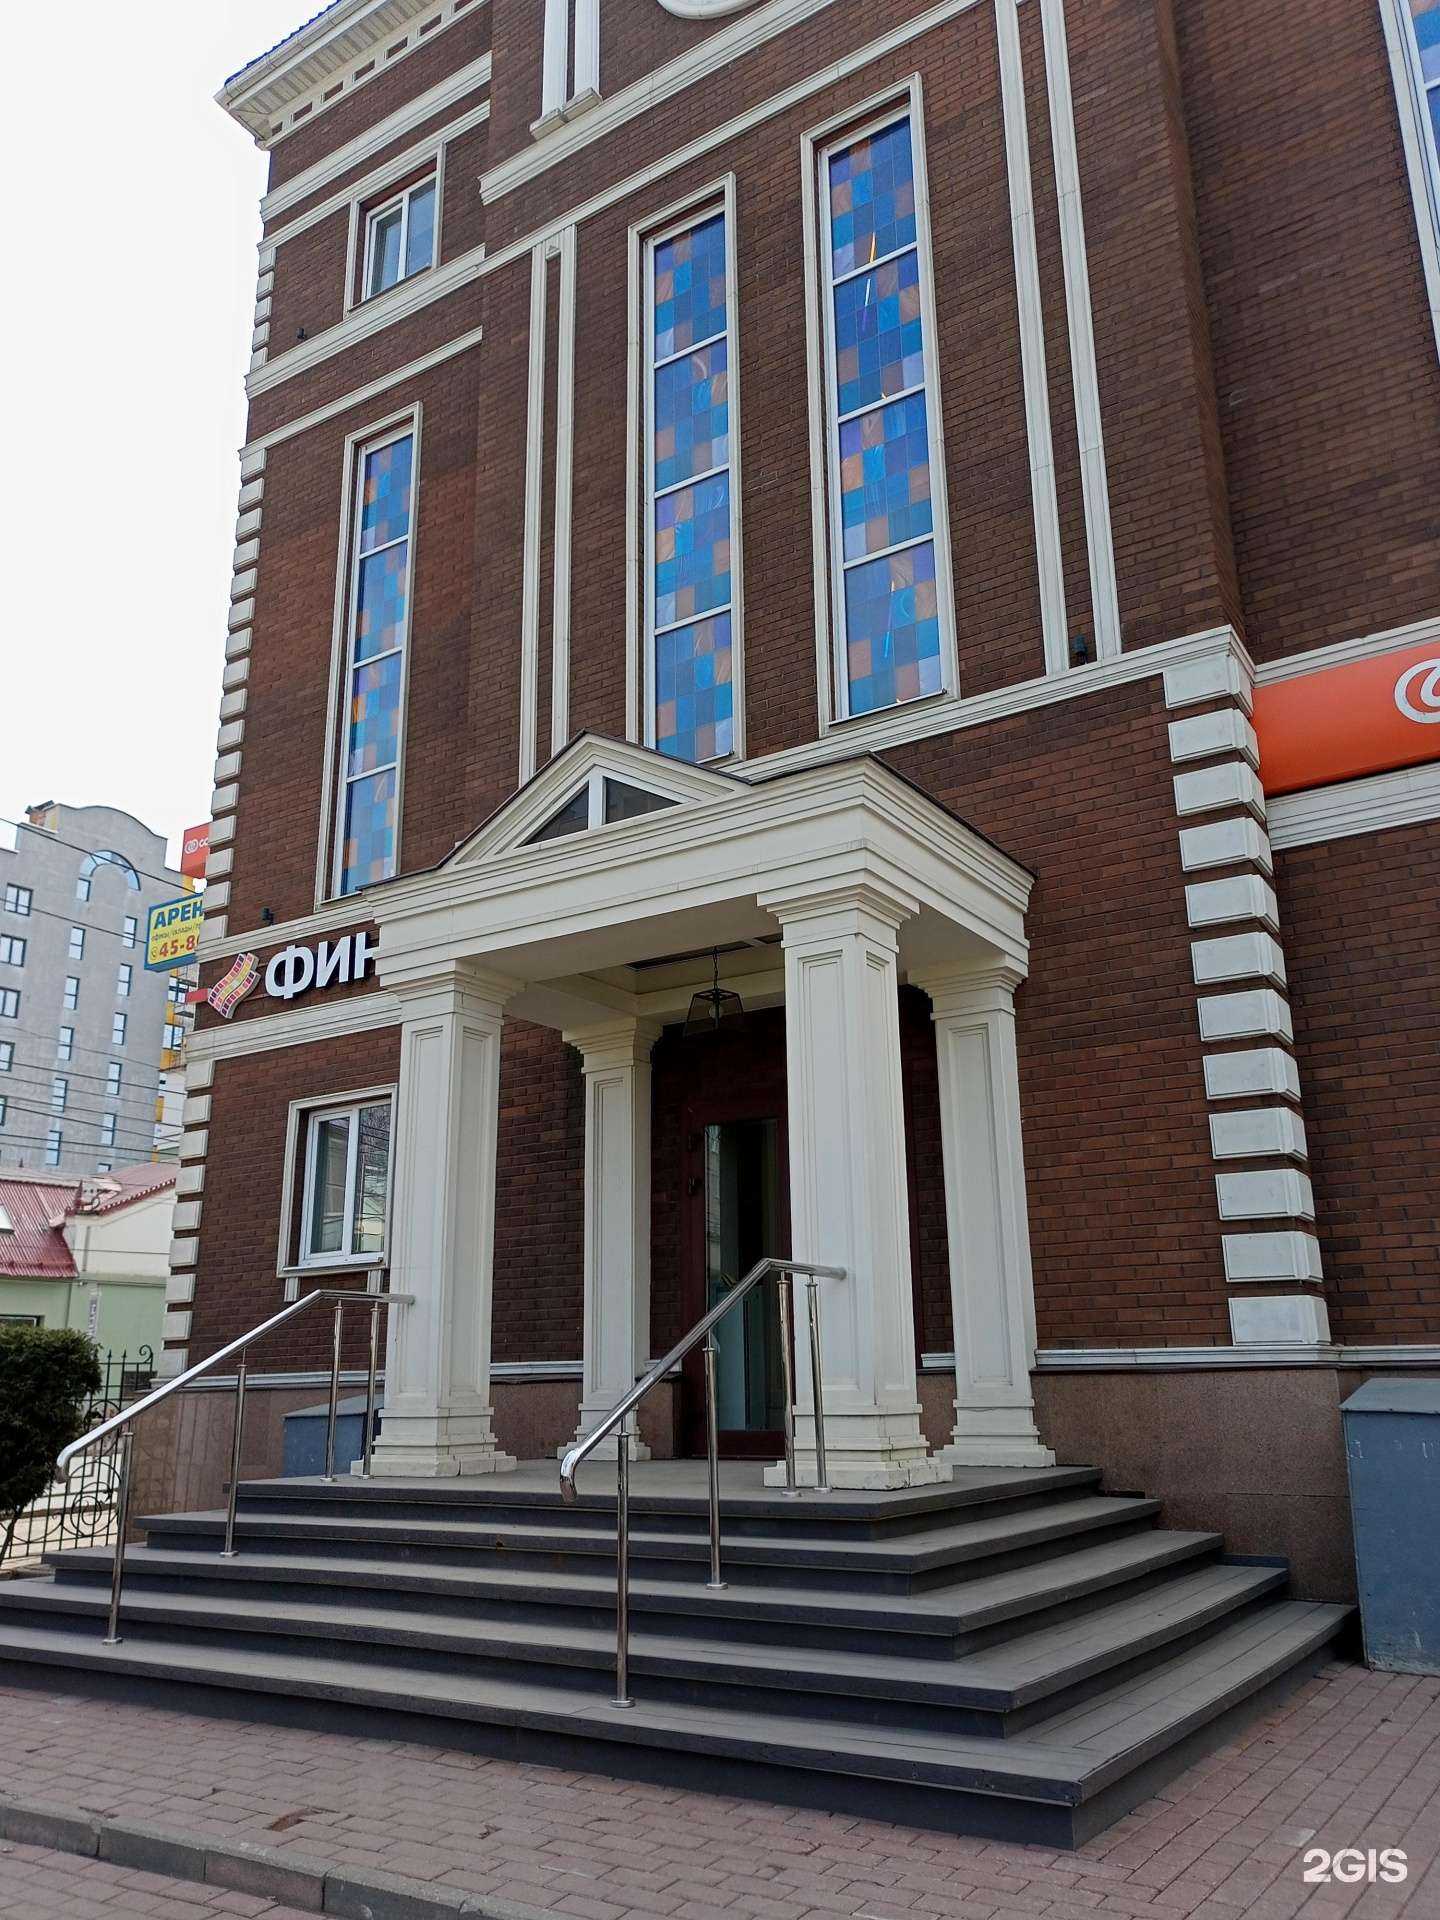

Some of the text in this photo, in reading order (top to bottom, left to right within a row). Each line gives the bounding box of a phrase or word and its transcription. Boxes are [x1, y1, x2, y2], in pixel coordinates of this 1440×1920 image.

[153, 899, 204, 930] АРЕН
[159, 934, 200, 957] 45-8
[264, 931, 381, 1000] ФИН
